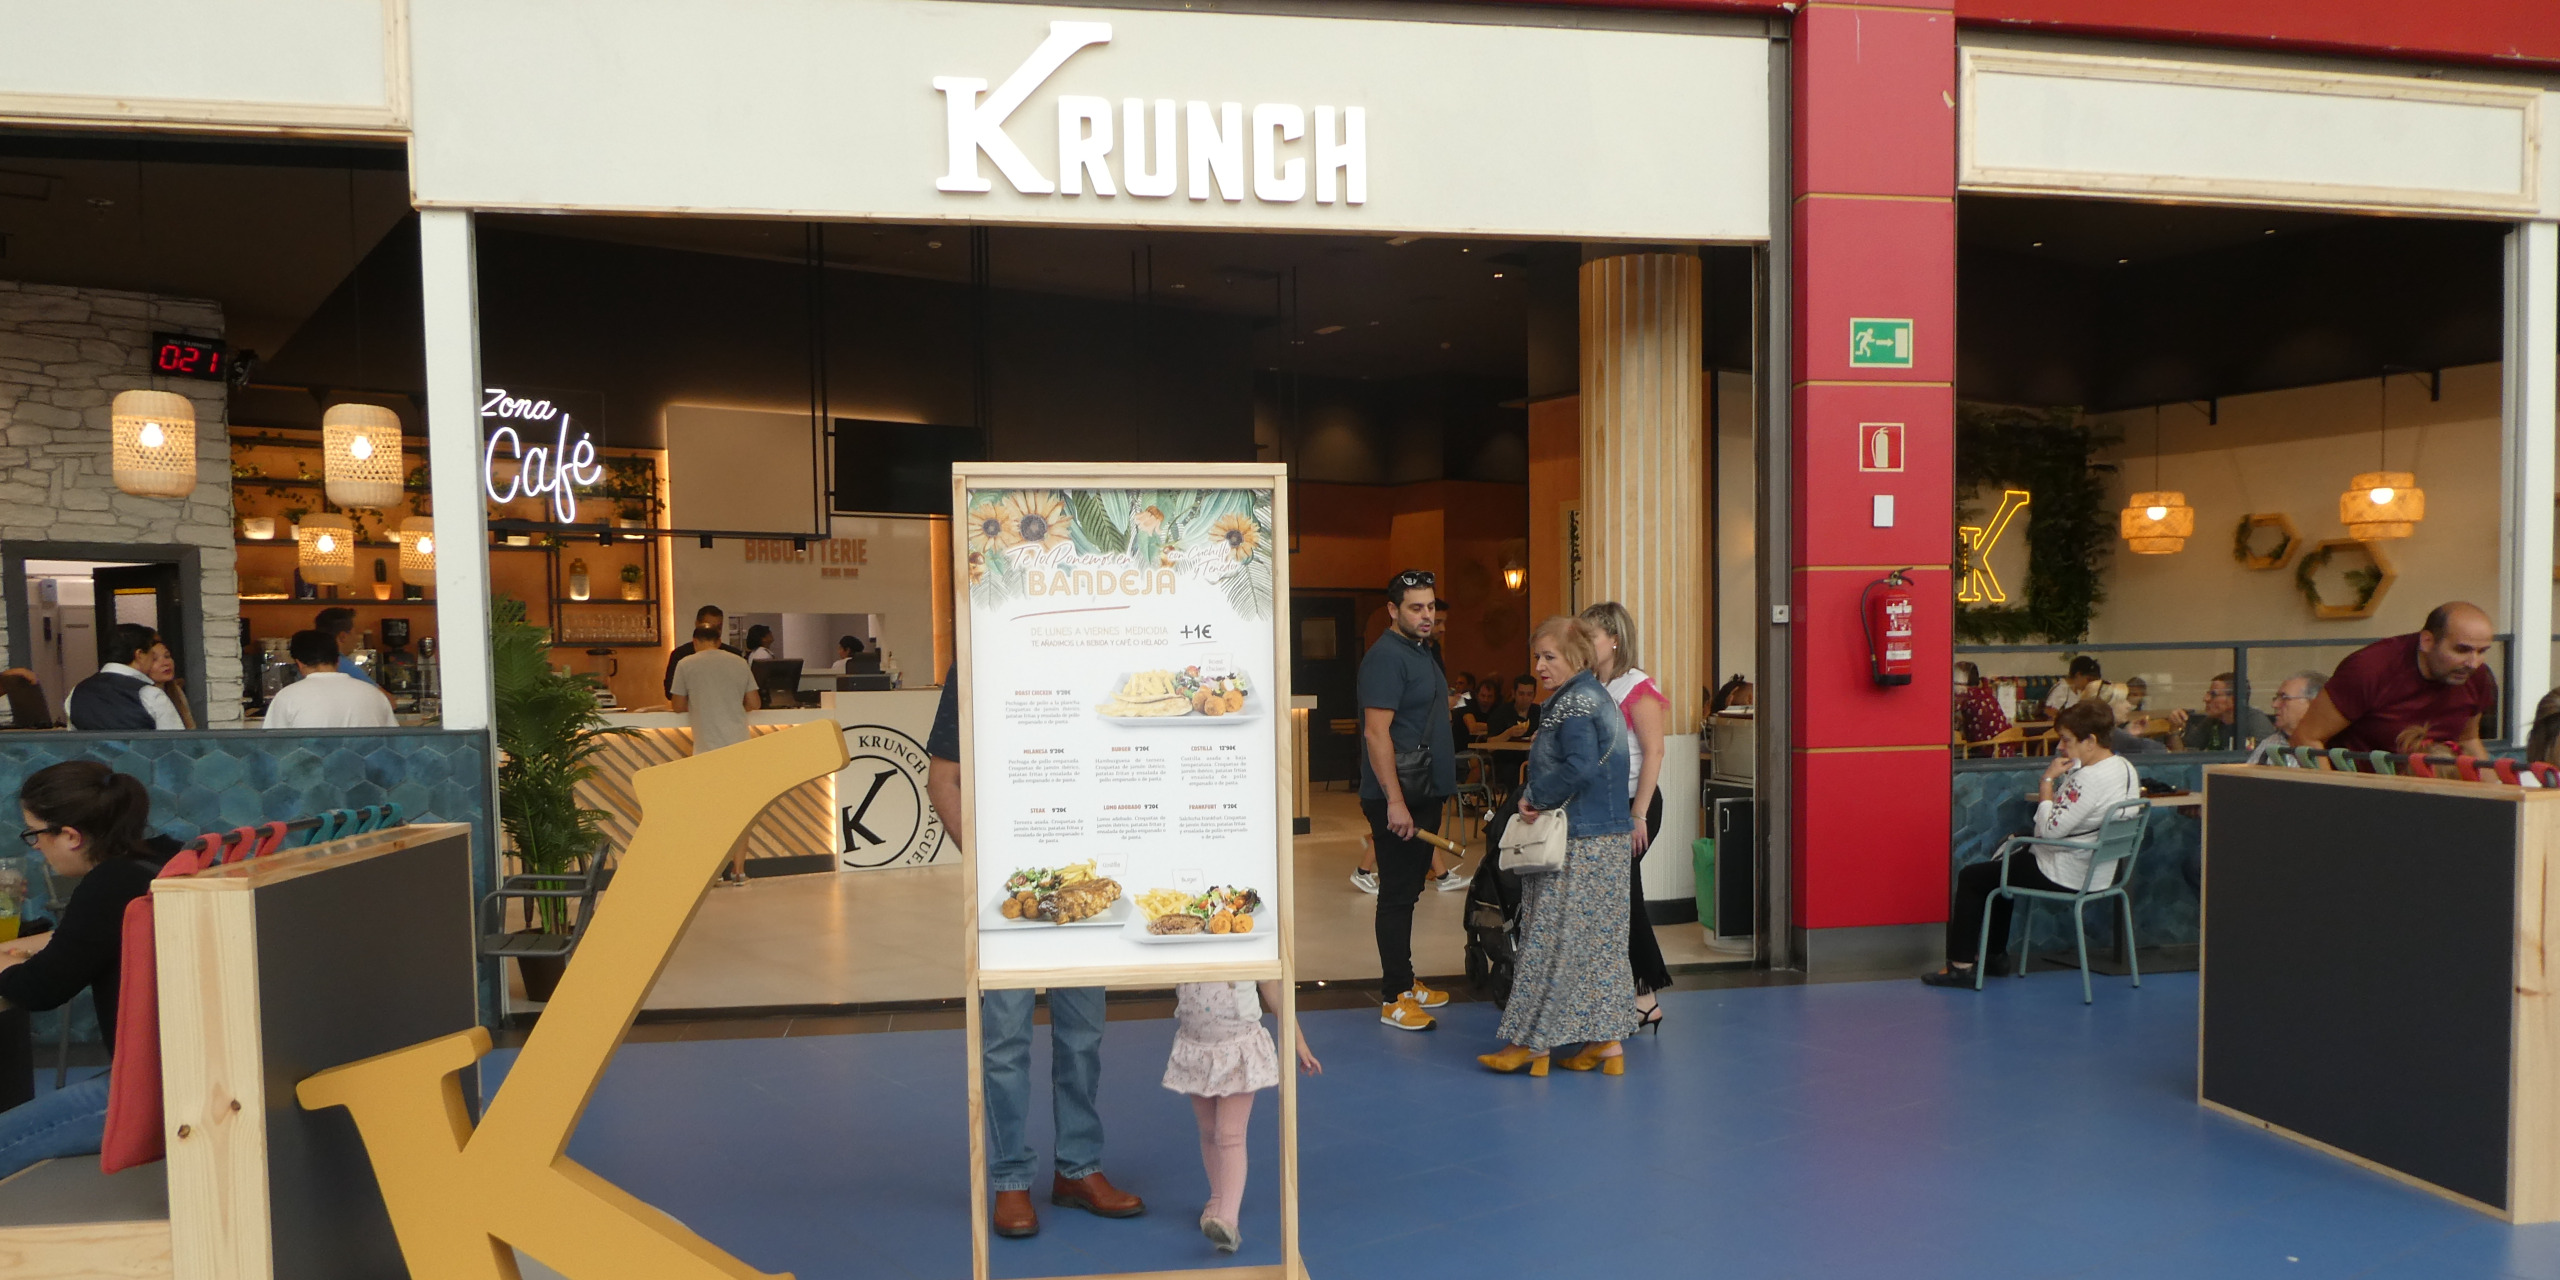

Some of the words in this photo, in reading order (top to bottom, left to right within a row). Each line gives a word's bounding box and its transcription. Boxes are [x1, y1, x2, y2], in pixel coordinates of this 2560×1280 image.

[932, 20, 1367, 205] KRUNCH
[159, 344, 219, 373] 021
[481, 388, 557, 420] Zona
[485, 413, 602, 524] Café
[1958, 489, 2030, 603] K
[1028, 570, 1176, 596] BANDEJA
[1045, 627, 1072, 636] LUNES
[1084, 627, 1120, 636] VIERNES
[1180, 624, 1212, 639] +1€
[858, 735, 927, 775] KRUNCH
[842, 768, 898, 854] K
[906, 804, 939, 865] BAGUE
[296, 718, 851, 1280] K
